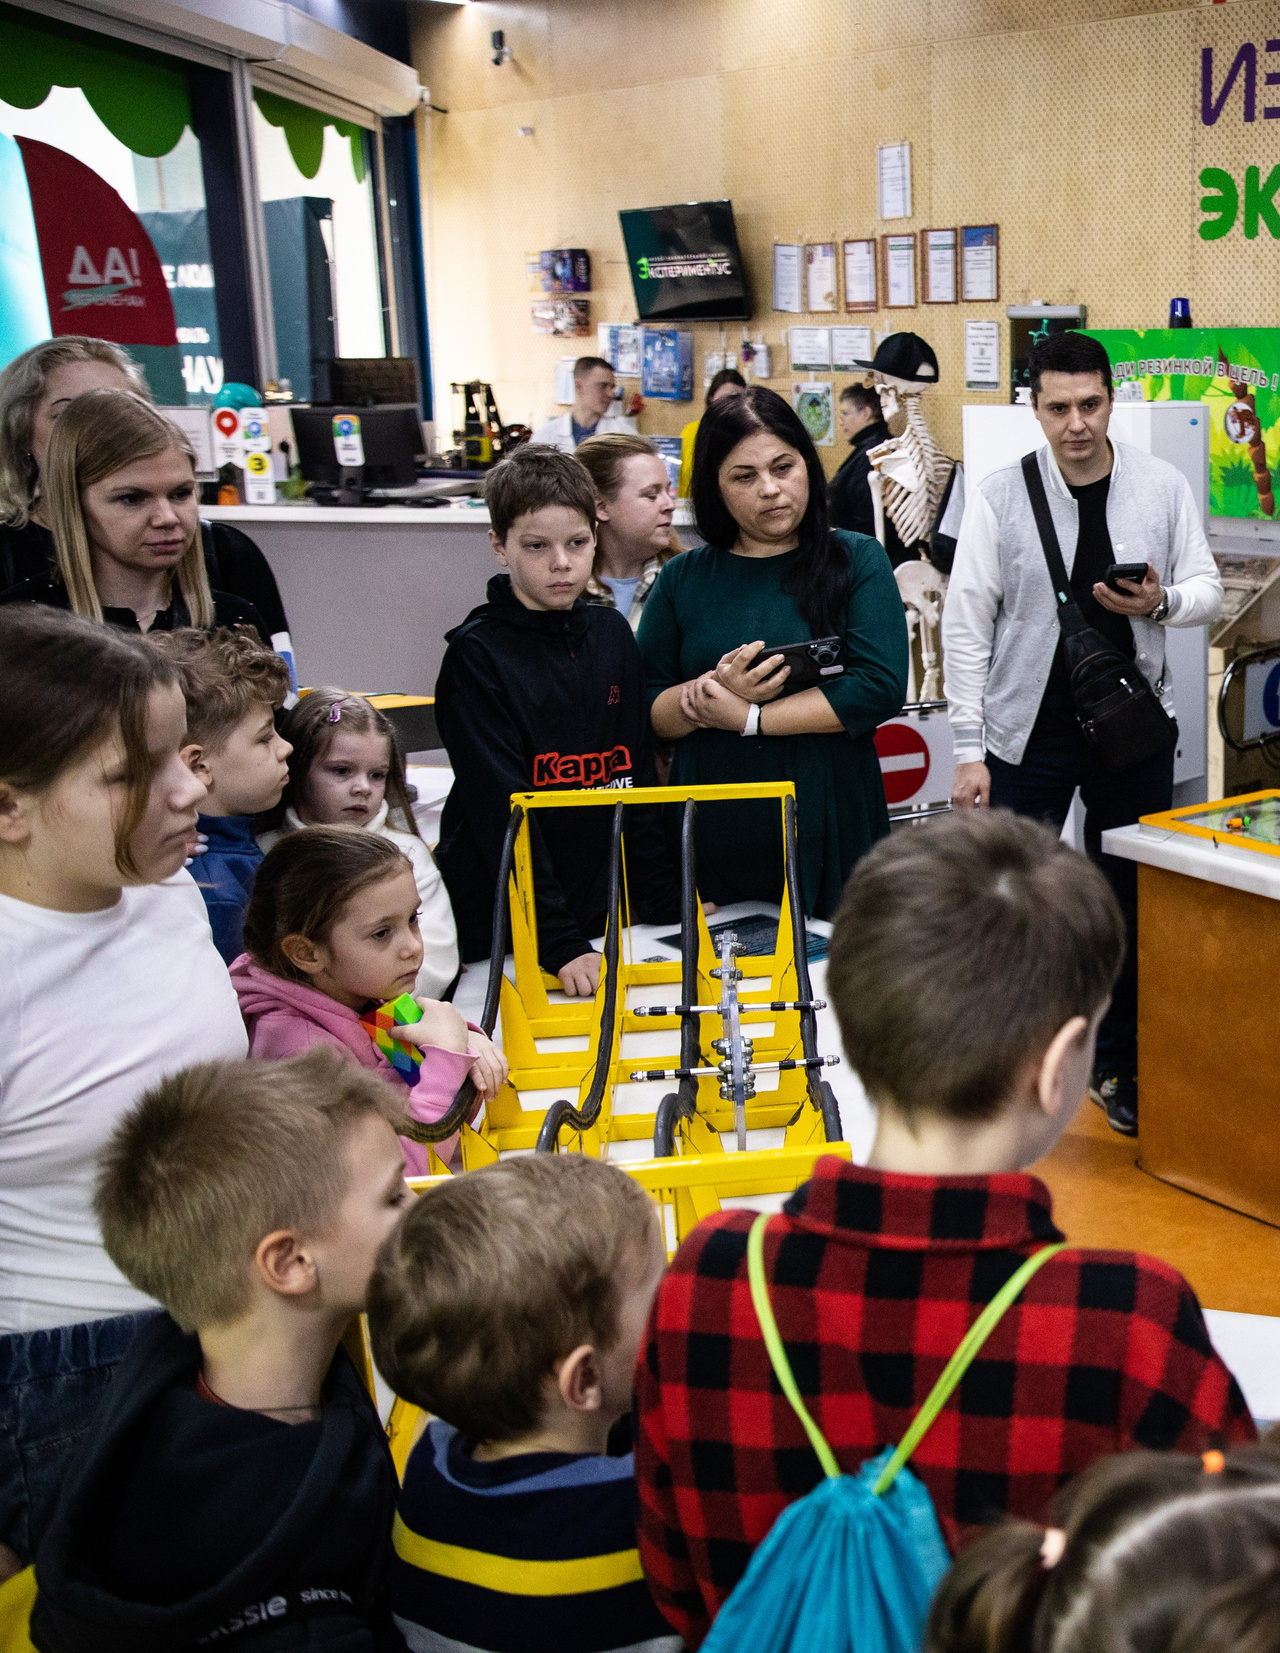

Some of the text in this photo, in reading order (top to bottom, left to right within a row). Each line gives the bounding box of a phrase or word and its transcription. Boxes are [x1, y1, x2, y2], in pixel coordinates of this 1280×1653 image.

[68, 246, 142, 287] ДА!
[1111, 360, 1136, 381] АДИ
[1138, 356, 1214, 377] РЕЗИНКОЙ
[1217, 361, 1226, 378] В
[1229, 365, 1269, 388] ЦЕЛЬ
[533, 745, 633, 787] Kappa
